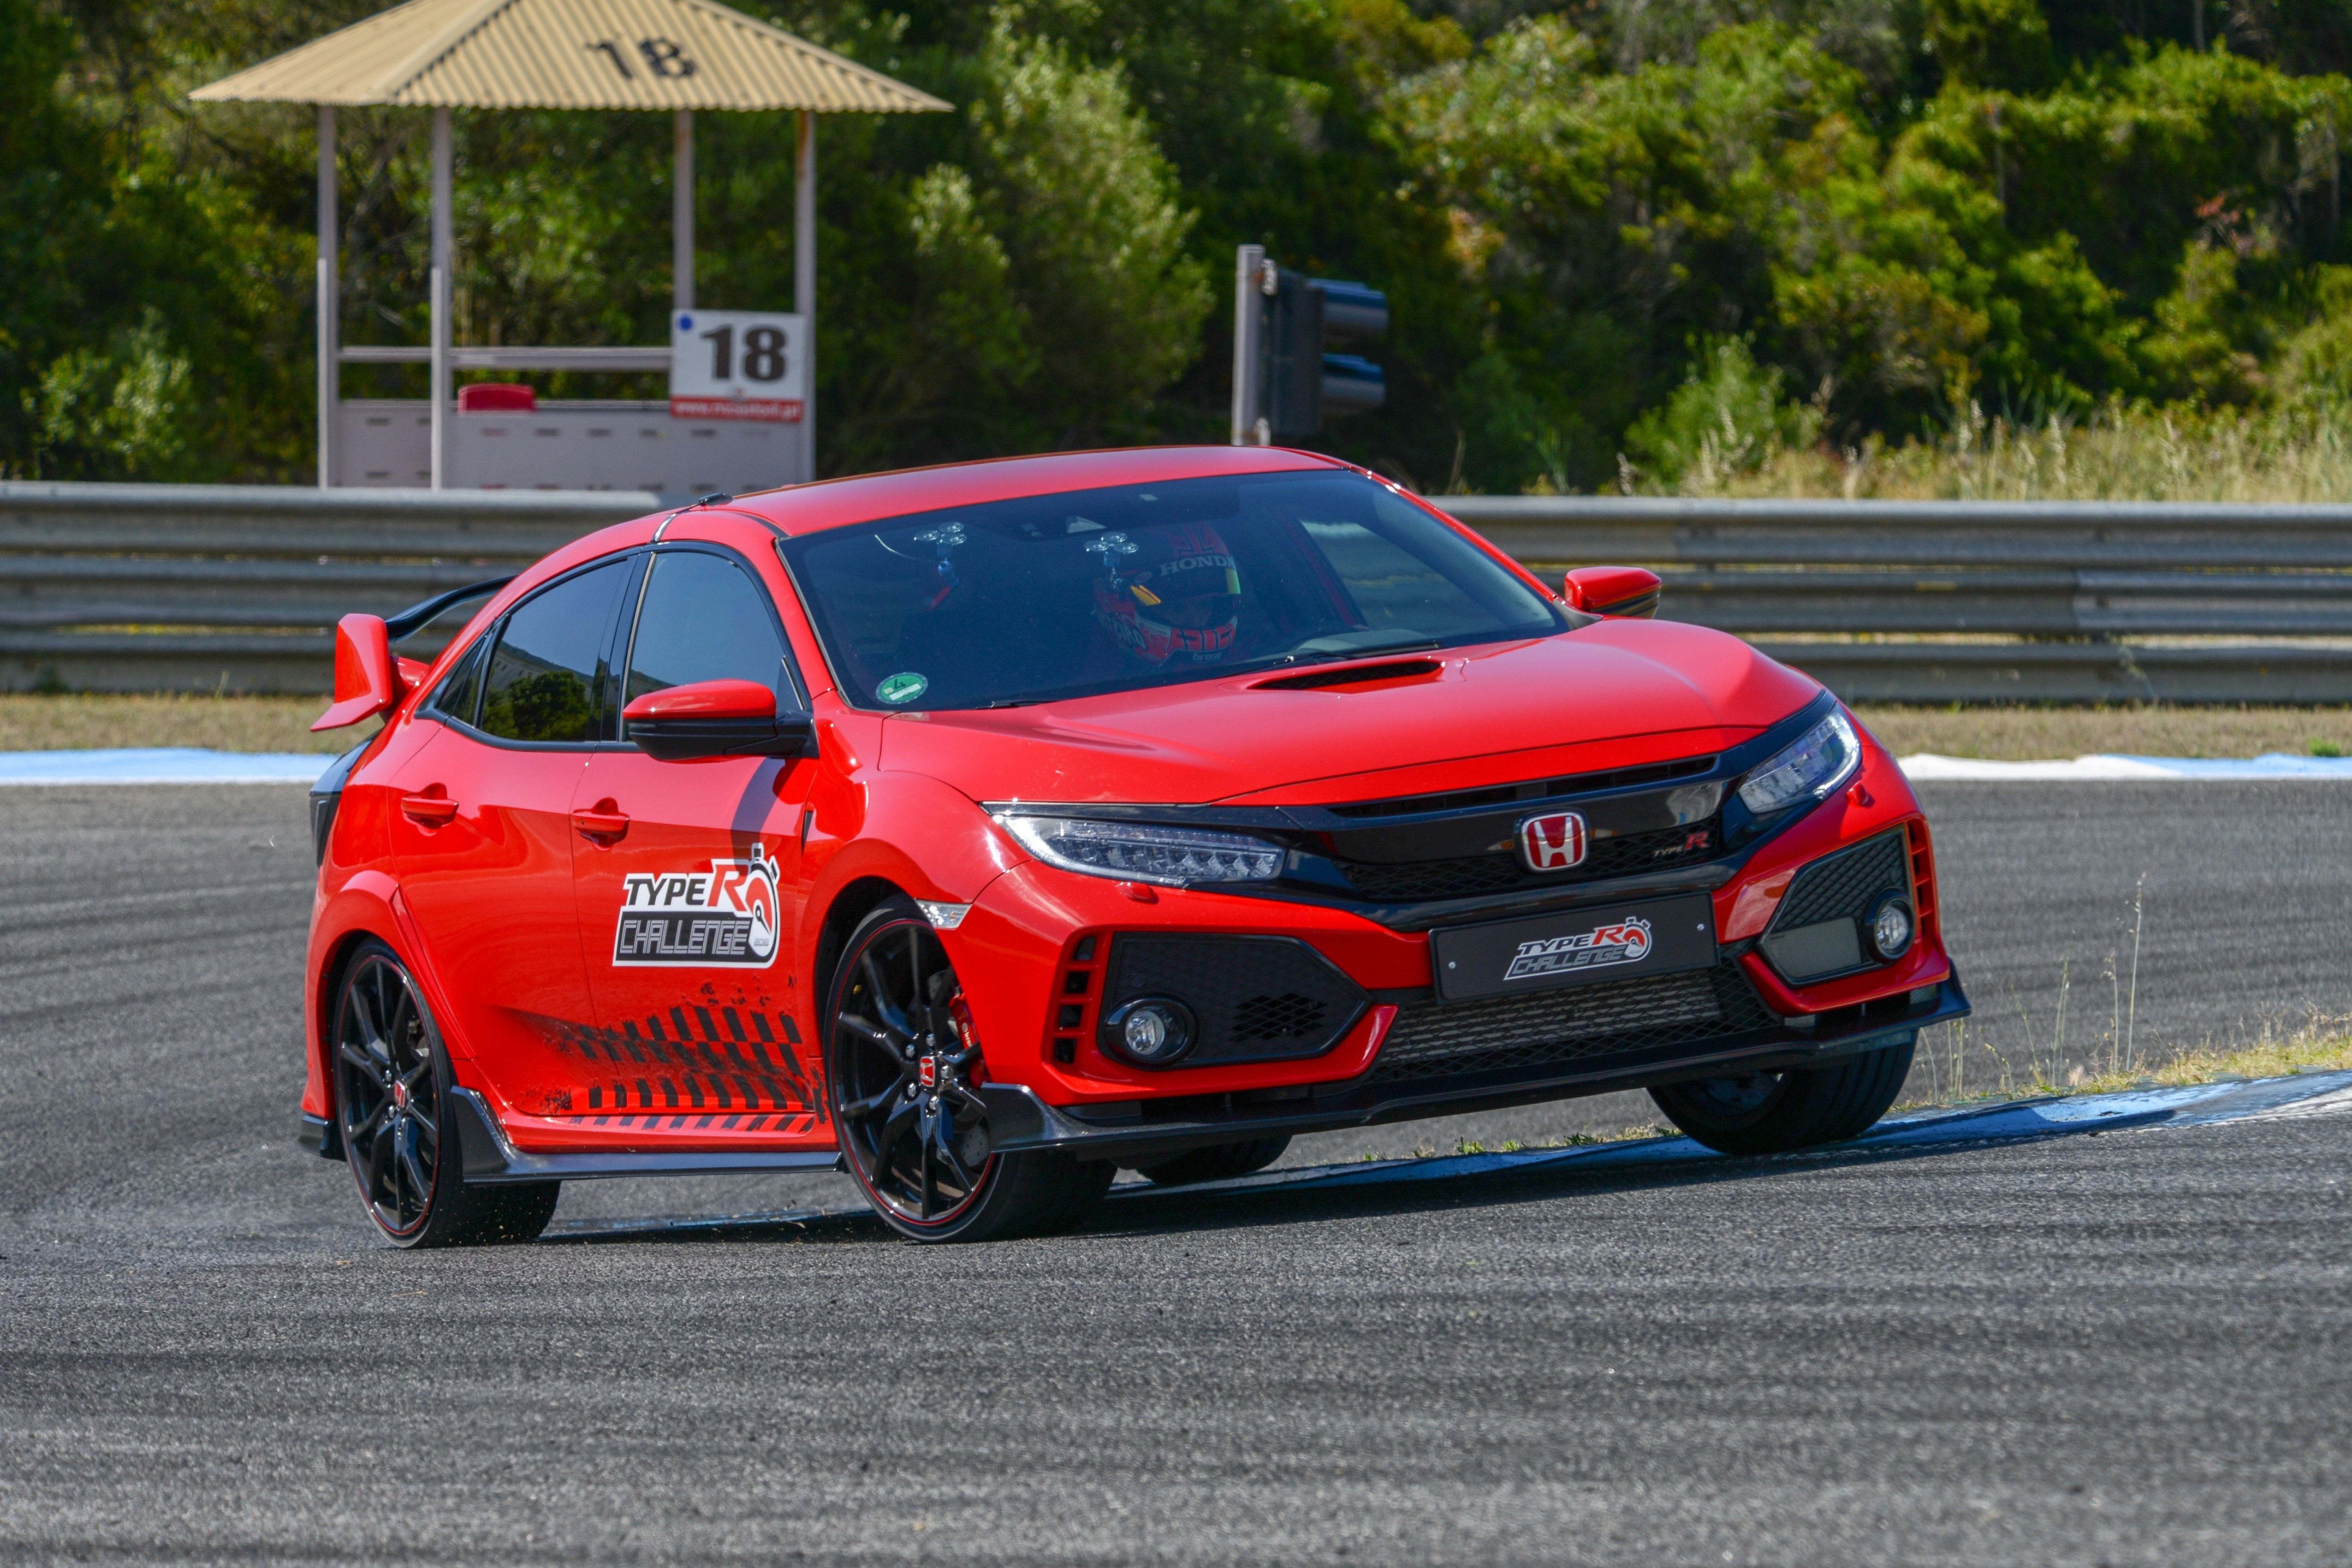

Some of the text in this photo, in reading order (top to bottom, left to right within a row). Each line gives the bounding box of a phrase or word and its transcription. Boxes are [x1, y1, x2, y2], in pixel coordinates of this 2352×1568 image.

[585, 38, 695, 80] 18
[700, 325, 786, 381] 18
[1159, 555, 1236, 576] HONDA
[1193, 652, 1222, 660] brose
[894, 678, 906, 689] 4
[1653, 831, 1709, 856] TYPE R
[627, 864, 749, 912] TYPE R
[620, 920, 750, 955] CHALLENGE
[1521, 926, 1625, 956] TYPE R
[1511, 945, 1626, 974] CHALLENGE
